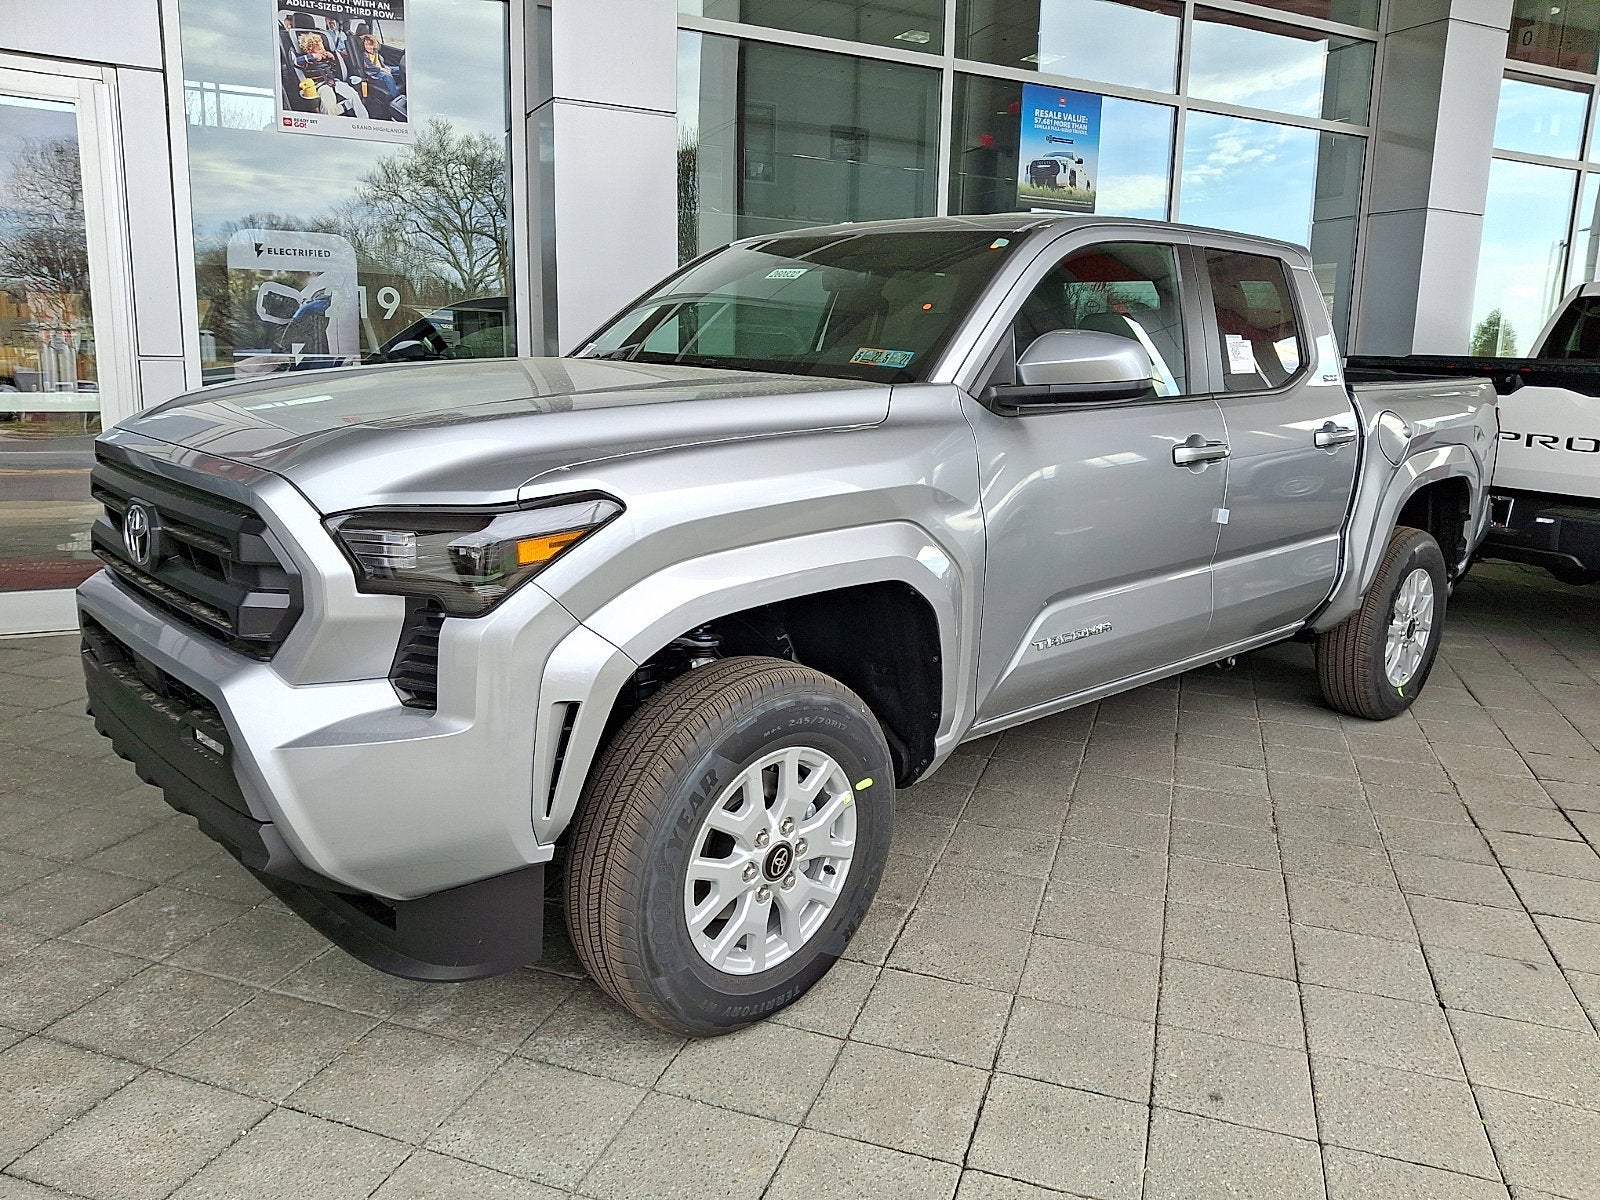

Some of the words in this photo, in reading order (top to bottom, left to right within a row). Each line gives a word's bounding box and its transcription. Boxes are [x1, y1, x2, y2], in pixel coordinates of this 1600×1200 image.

[286, 0, 344, 13] ADULT-SIZED
[345, 6, 371, 16] THIRD
[373, 10, 397, 20] ROW.
[352, 0, 375, 9] WITH
[378, 2, 390, 10] AN
[1034, 109, 1062, 120] RESALE
[1063, 113, 1089, 124] VALUE:
[373, 126, 409, 134] HIGHLANDER
[1053, 120, 1071, 129] MORE
[1072, 122, 1088, 131] THAN
[267, 247, 331, 258] ELECTRIFIED
[1031, 621, 1113, 651] TACOMA
